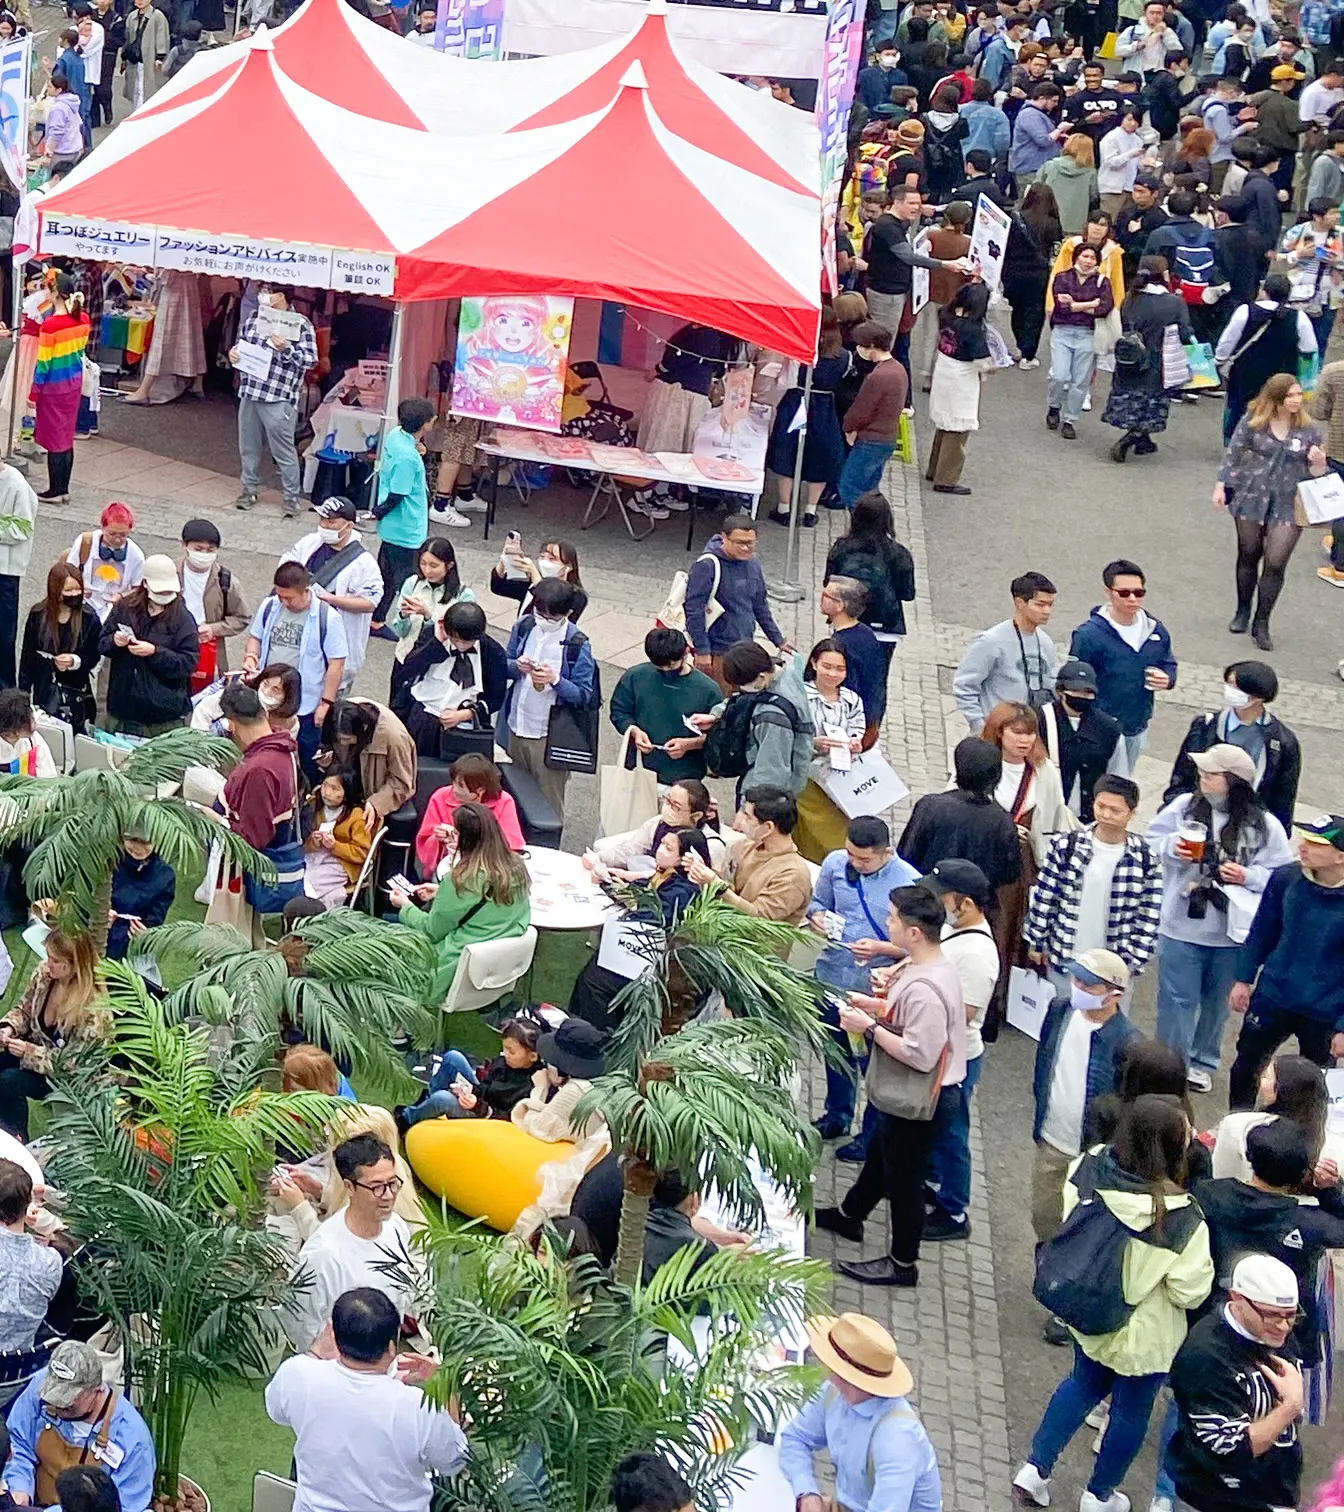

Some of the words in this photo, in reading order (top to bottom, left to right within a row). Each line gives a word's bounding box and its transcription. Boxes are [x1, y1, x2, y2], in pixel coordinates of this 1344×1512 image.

[46, 220, 152, 246] 耳つぼジュエリー
[75, 243, 119, 255] やってます
[182, 256, 301, 278] お気軽にお声がけください
[336, 259, 374, 273] English
[375, 264, 392, 274] OK
[365, 276, 382, 286] OK
[852, 774, 880, 797] MOVE
